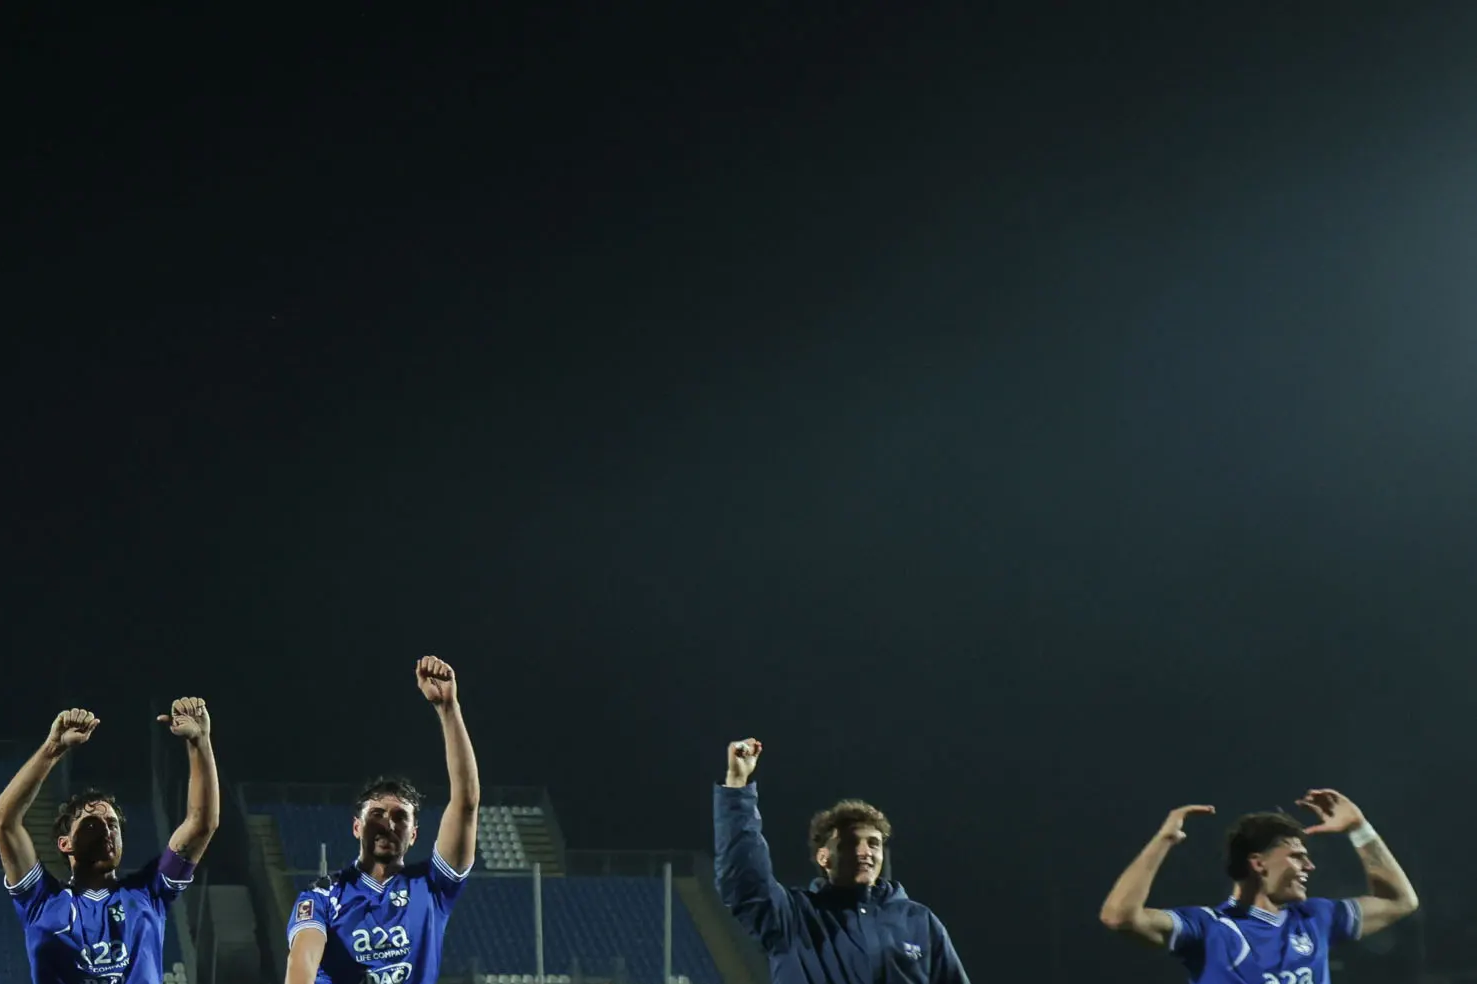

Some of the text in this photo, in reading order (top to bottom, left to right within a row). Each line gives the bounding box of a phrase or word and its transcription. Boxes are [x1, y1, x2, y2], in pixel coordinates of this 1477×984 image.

[352, 925, 410, 953] a2a
[355, 947, 412, 963] LIFE COMPANY
